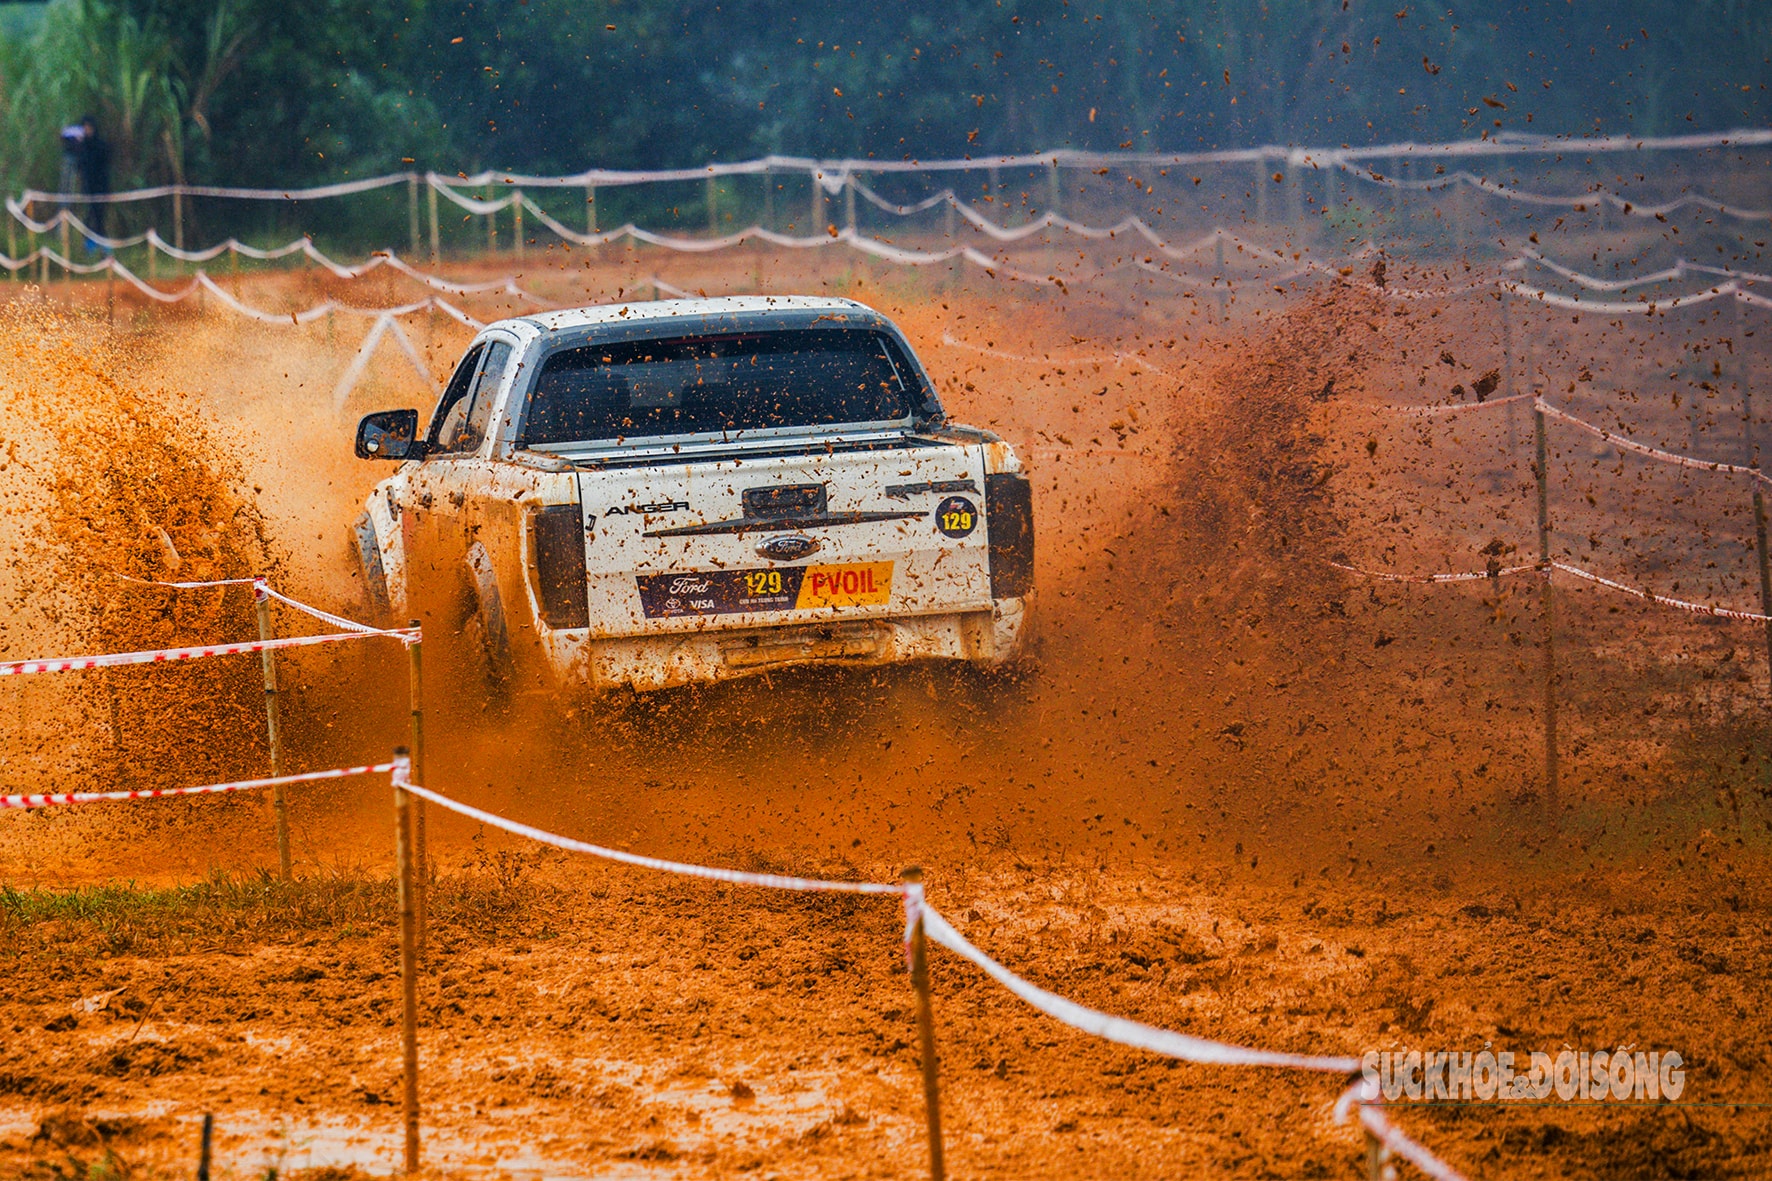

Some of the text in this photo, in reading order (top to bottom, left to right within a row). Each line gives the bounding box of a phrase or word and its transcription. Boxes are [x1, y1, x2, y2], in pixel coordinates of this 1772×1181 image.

[942, 512, 971, 531] 129
[775, 540, 804, 554] Ford
[669, 577, 709, 595] Ford
[744, 571, 782, 595] 129
[812, 568, 878, 596] PVOIL
[689, 599, 715, 609] VISA
